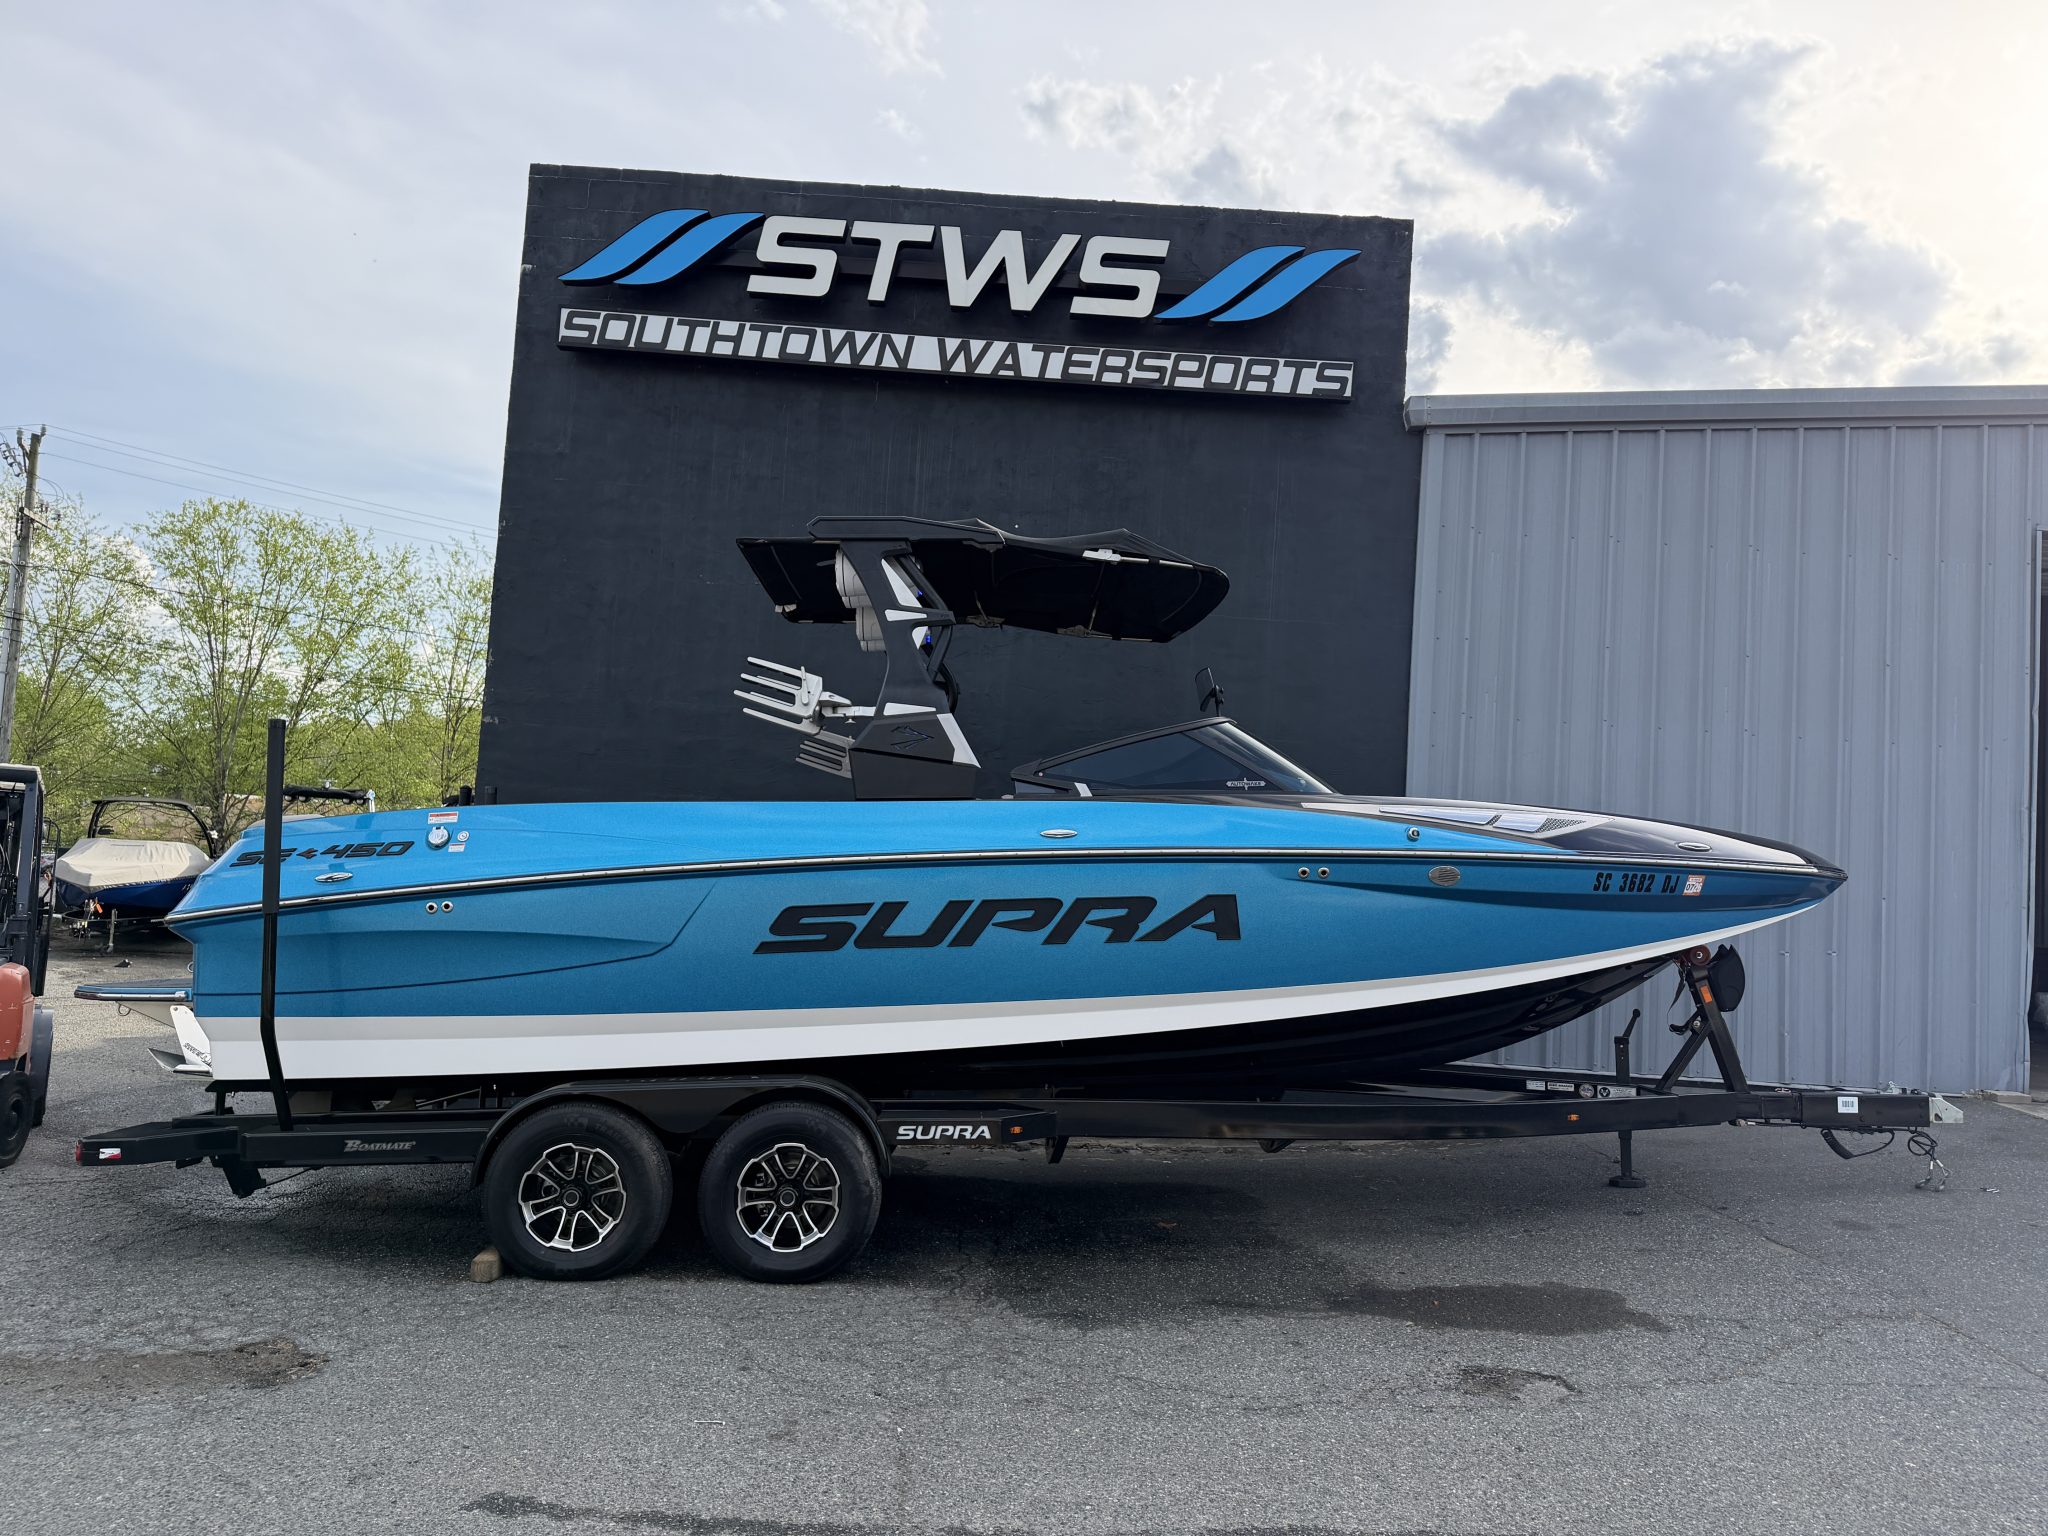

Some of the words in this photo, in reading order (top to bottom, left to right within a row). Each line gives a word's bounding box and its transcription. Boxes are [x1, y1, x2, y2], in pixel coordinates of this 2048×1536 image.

[746, 215, 1170, 318] STWS
[560, 309, 915, 370] SOUTHTOWN
[936, 337, 1354, 397] WATERSPORTS
[1593, 872, 1612, 892] SC
[1619, 873, 1656, 893] 3682
[1661, 874, 1680, 893] DJ
[752, 894, 1241, 955] SUPRA
[896, 1125, 991, 1140] SUPRA
